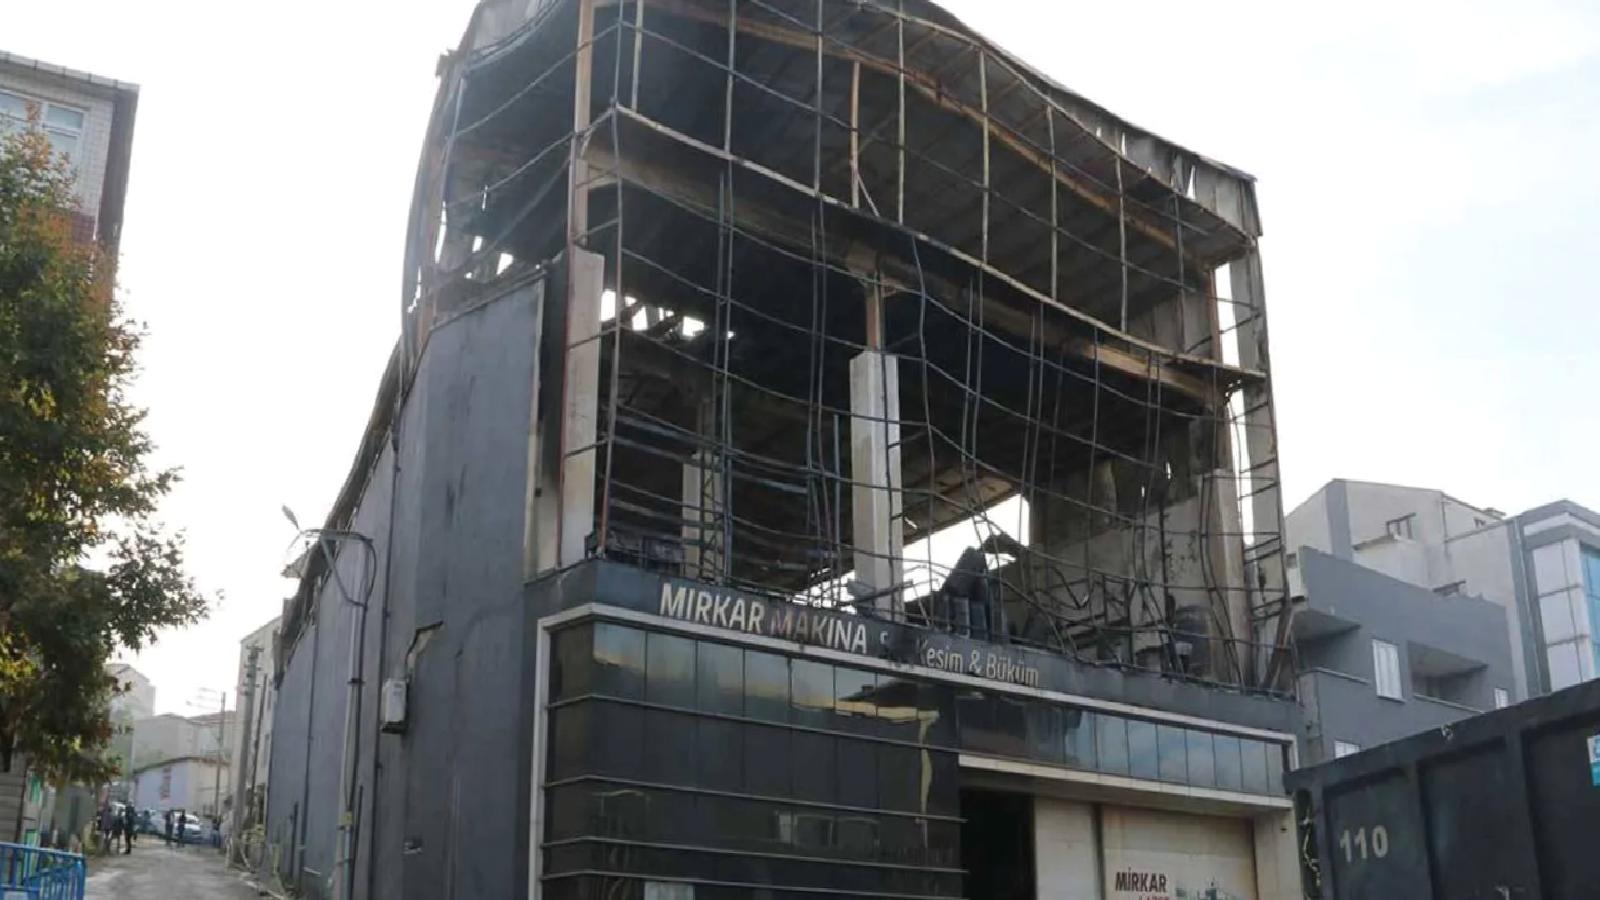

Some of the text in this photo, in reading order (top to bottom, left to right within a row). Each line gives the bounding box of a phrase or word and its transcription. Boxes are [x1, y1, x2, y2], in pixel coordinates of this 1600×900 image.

[660, 582, 764, 634] MIRKAR
[968, 650, 982, 674] &
[986, 653, 1039, 688] Büküm
[1340, 825, 1388, 862] 110
[1115, 867, 1167, 893] MİRKAR
